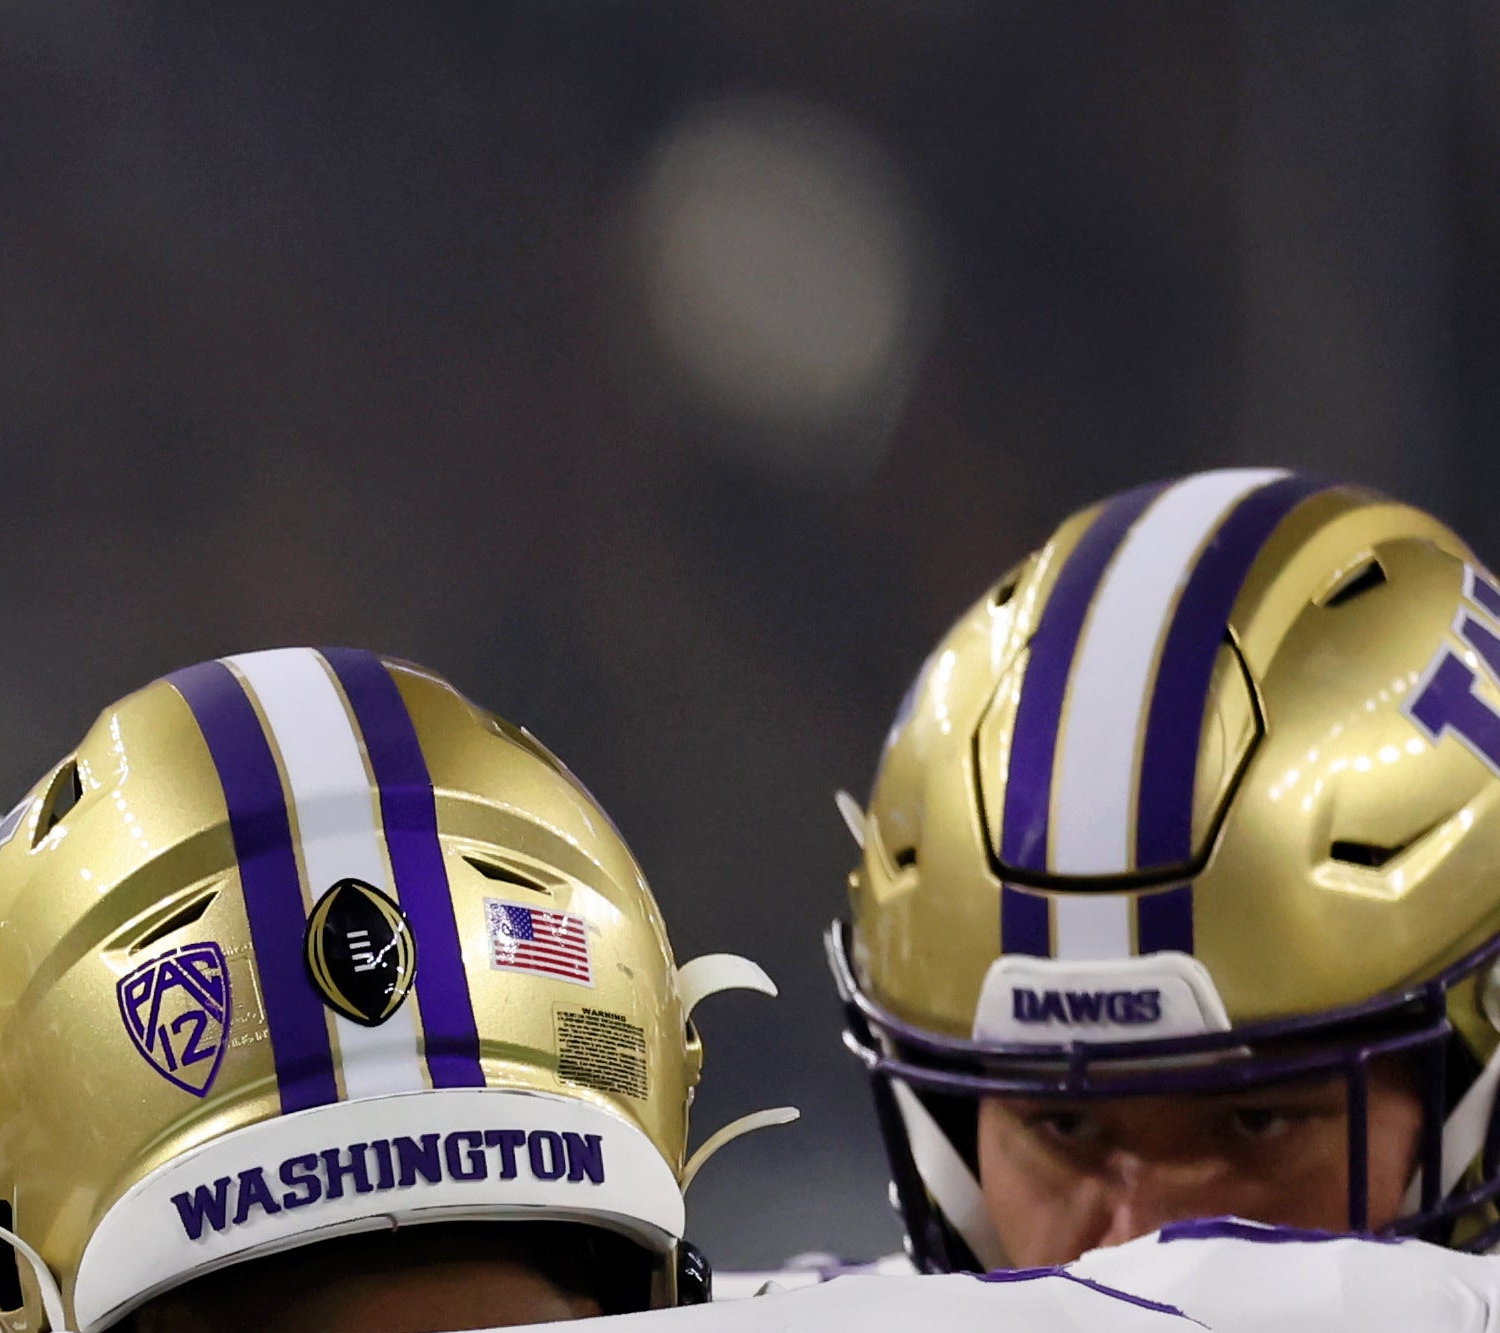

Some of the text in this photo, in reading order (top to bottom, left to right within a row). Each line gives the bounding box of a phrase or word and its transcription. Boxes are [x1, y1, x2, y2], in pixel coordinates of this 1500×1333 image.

[1011, 987, 1162, 1025] DAWGS
[158, 1010, 216, 1072] 12
[171, 1129, 604, 1241] WASHINGTON
